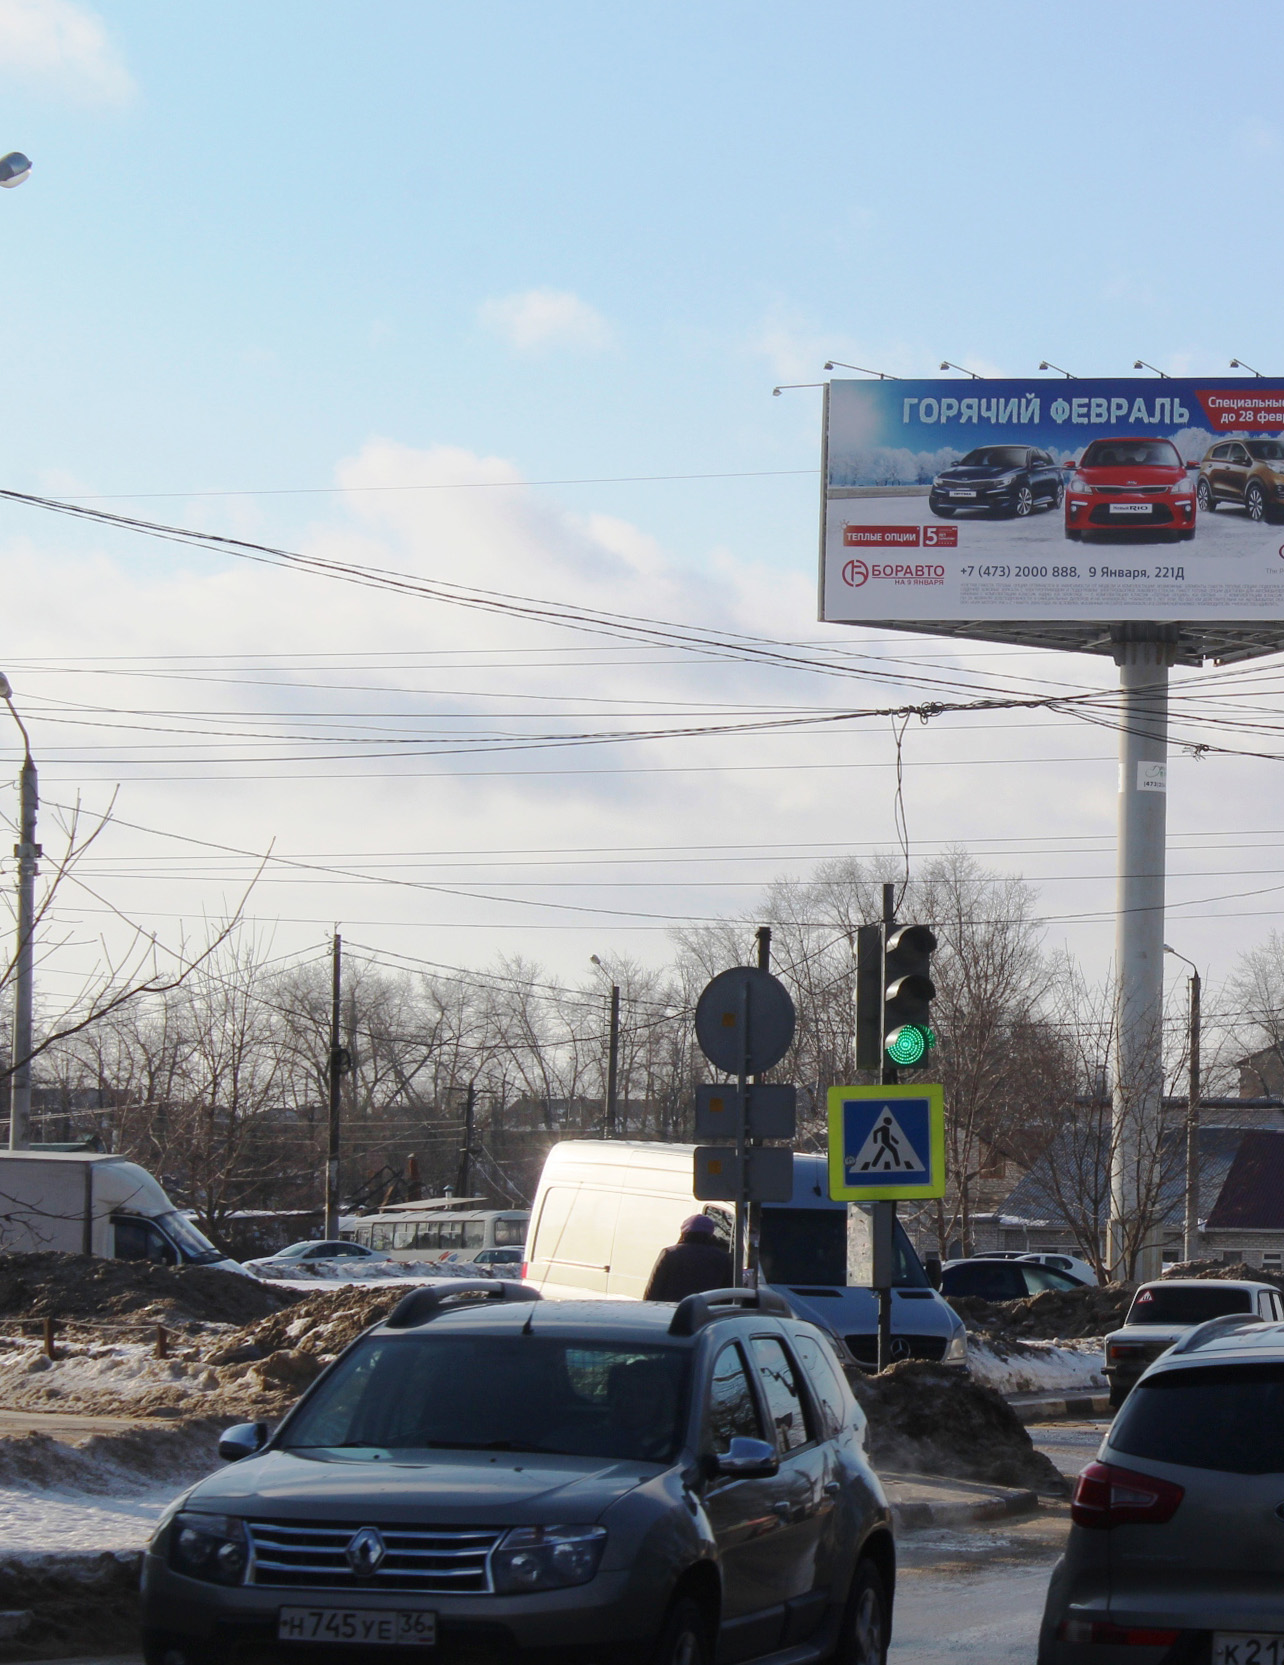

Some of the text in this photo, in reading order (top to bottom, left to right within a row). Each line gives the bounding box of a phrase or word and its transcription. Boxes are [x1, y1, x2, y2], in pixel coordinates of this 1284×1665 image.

[903, 393, 1190, 424] ГОРЯЧИЙ ФЕВРАЛЬ
[1221, 413, 1236, 424] до
[1239, 411, 1254, 422] 28
[847, 533, 916, 543] ТЕПЛЫЕ ОПЦИИ
[925, 527, 938, 545] 5
[872, 564, 945, 577] БОРАВТО
[960, 565, 1185, 581] +7 (473) 2000 888, 9 Января, 221Д
[401, 1613, 426, 1633] 36
